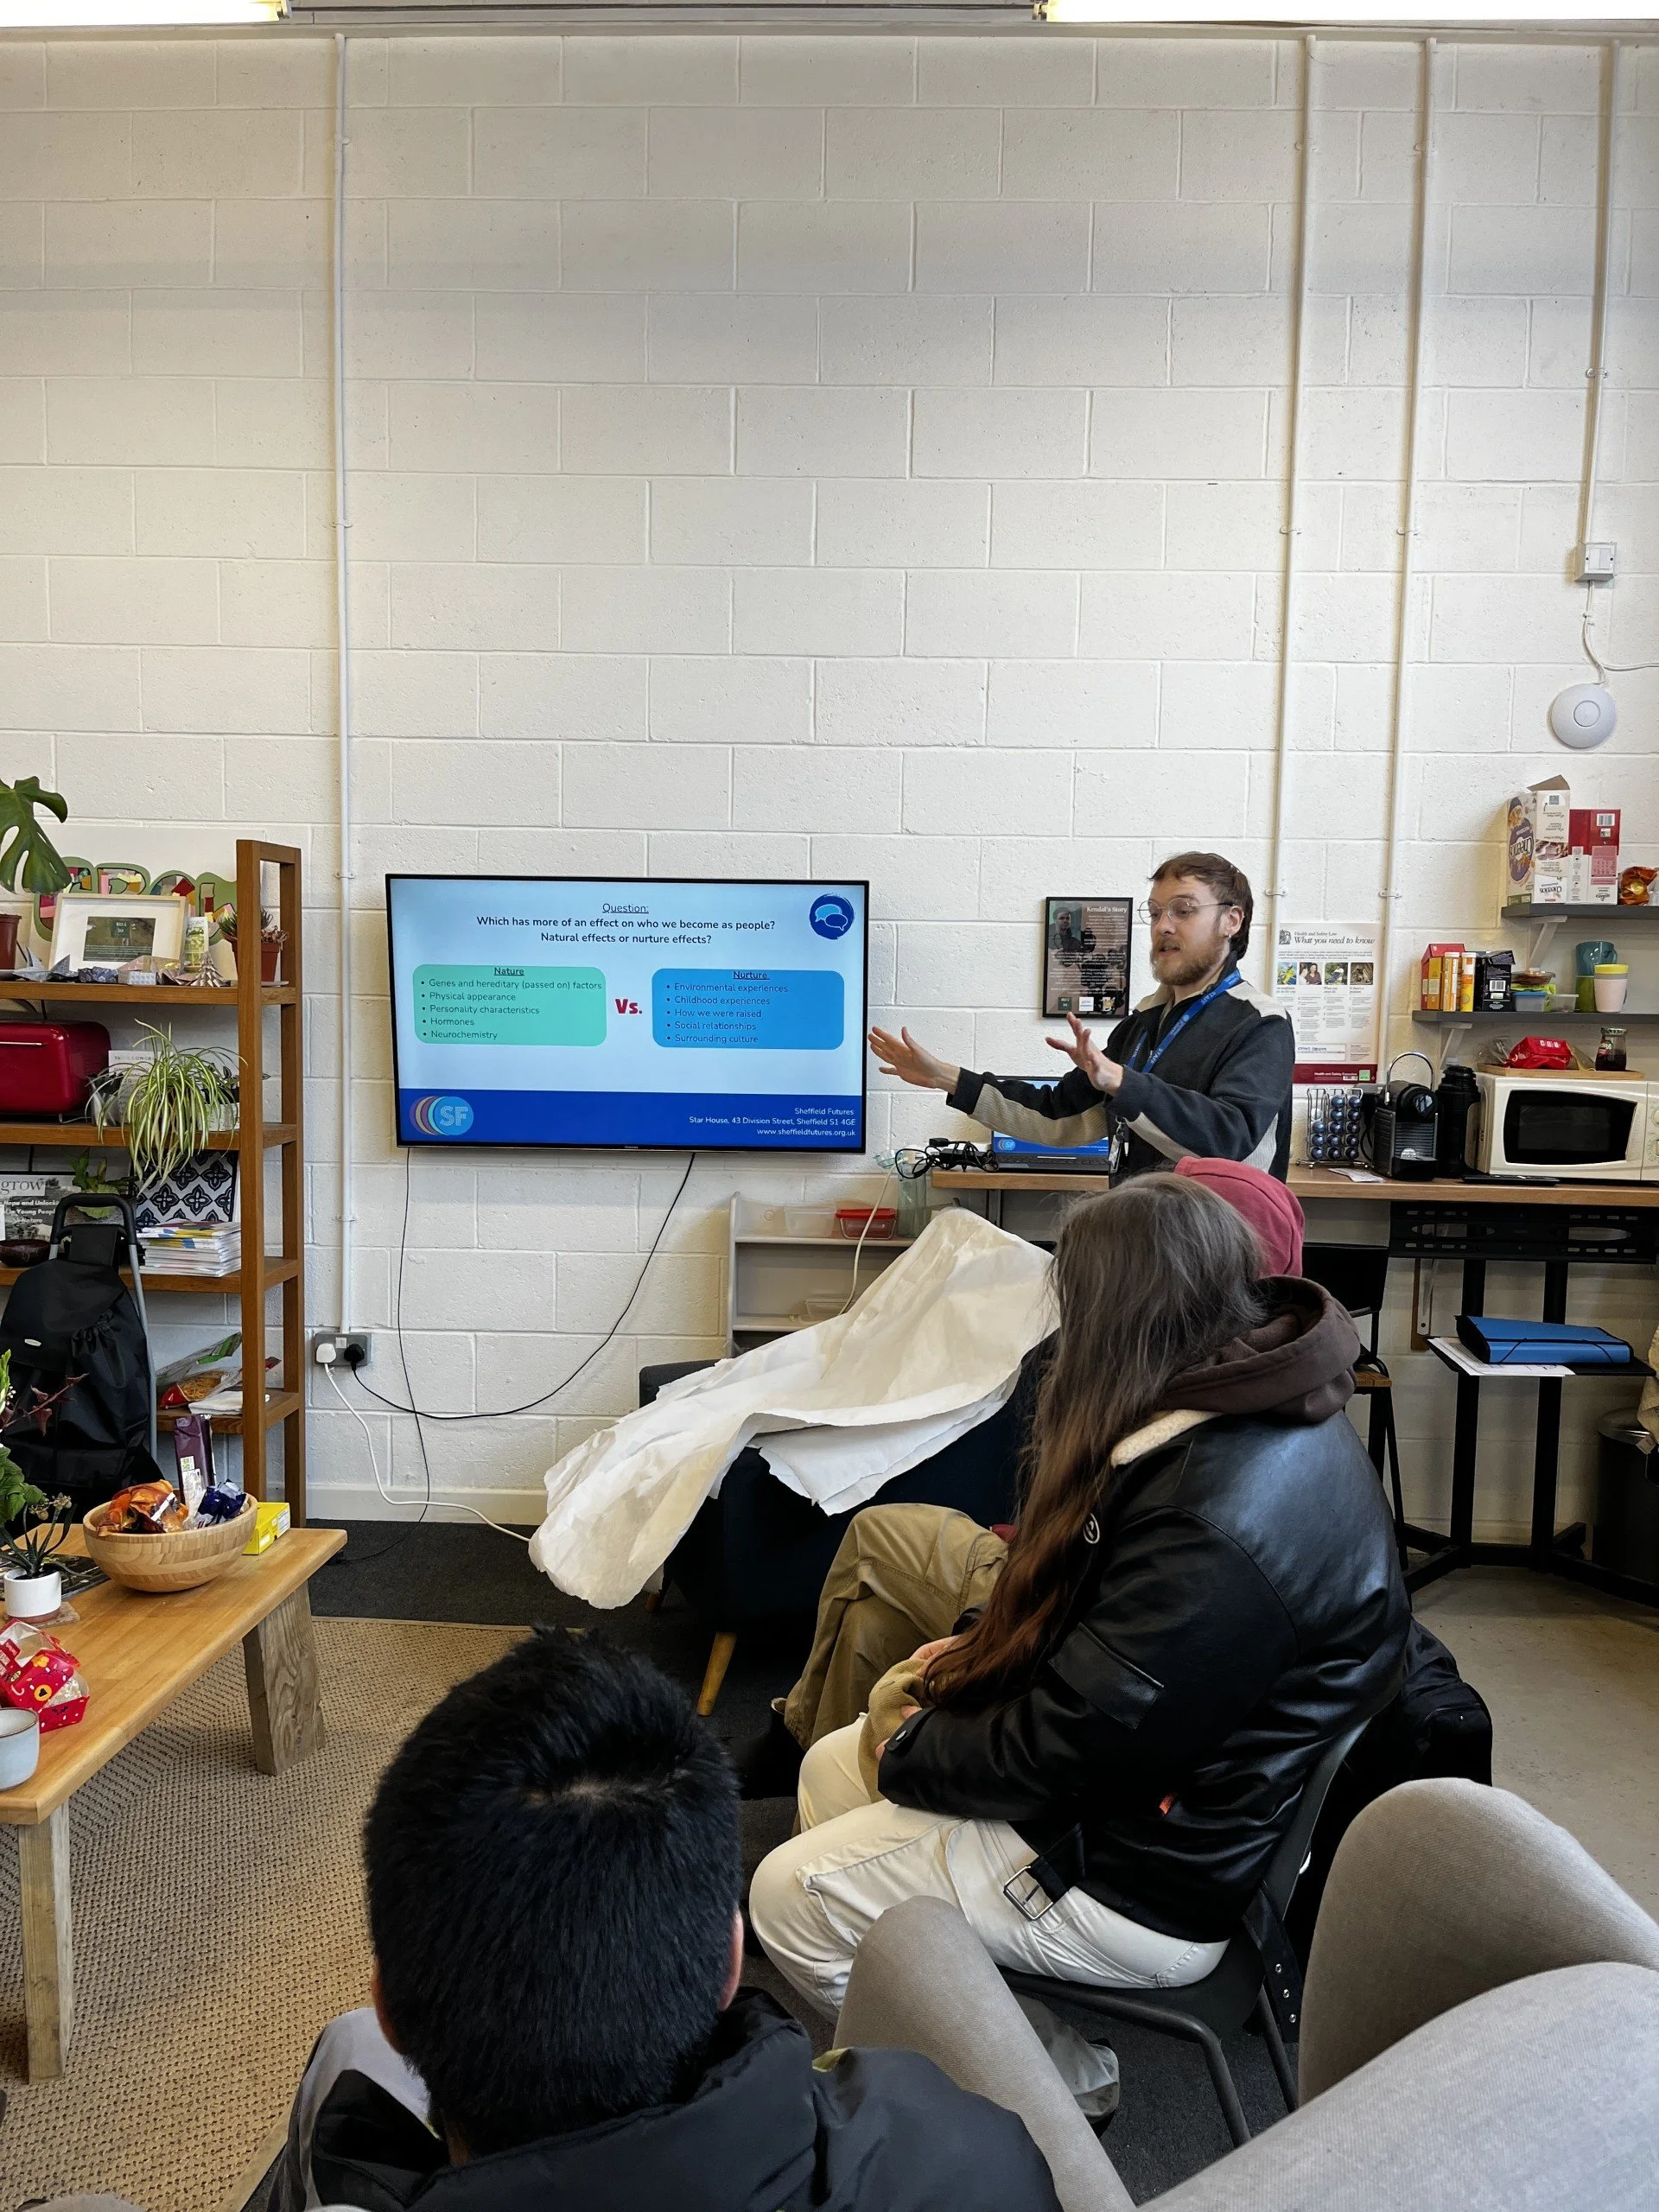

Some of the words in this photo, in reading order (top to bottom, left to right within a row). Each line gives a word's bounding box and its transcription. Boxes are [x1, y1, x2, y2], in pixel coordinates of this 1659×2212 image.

[602, 903, 649, 914] Question:
[477, 917, 509, 926] Which
[512, 918, 530, 926] has
[562, 918, 571, 927] of
[590, 918, 619, 927] effect
[637, 918, 658, 928] who
[680, 919, 719, 929] become
[735, 920, 775, 931] people?
[541, 932, 579, 942] Natural
[582, 933, 616, 943] effects
[632, 935, 669, 944] nurture
[672, 934, 712, 944] effects?
[494, 968, 524, 976] Nature
[733, 971, 770, 980] Nurture
[429, 979, 455, 988] Genes
[476, 981, 519, 989] hereditary
[675, 983, 735, 992] Environmental
[429, 992, 465, 1001] Physical
[467, 994, 516, 1002] appearance
[720, 997, 771, 1006] experiences
[430, 1005, 478, 1014] Personality
[480, 1006, 540, 1014] characteristics
[615, 999, 642, 1014] Vs.
[702, 1022, 756, 1031] relationships
[431, 1031, 498, 1039] Neurochemistry
[675, 1034, 727, 1044] Surrounding
[1151, 1048, 1163, 1064] STAFF
[440, 1106, 467, 1126] SF
[757, 1128, 855, 1137] www.sheffieldfutures.org.uk
[1, 1179, 45, 1195] grow
